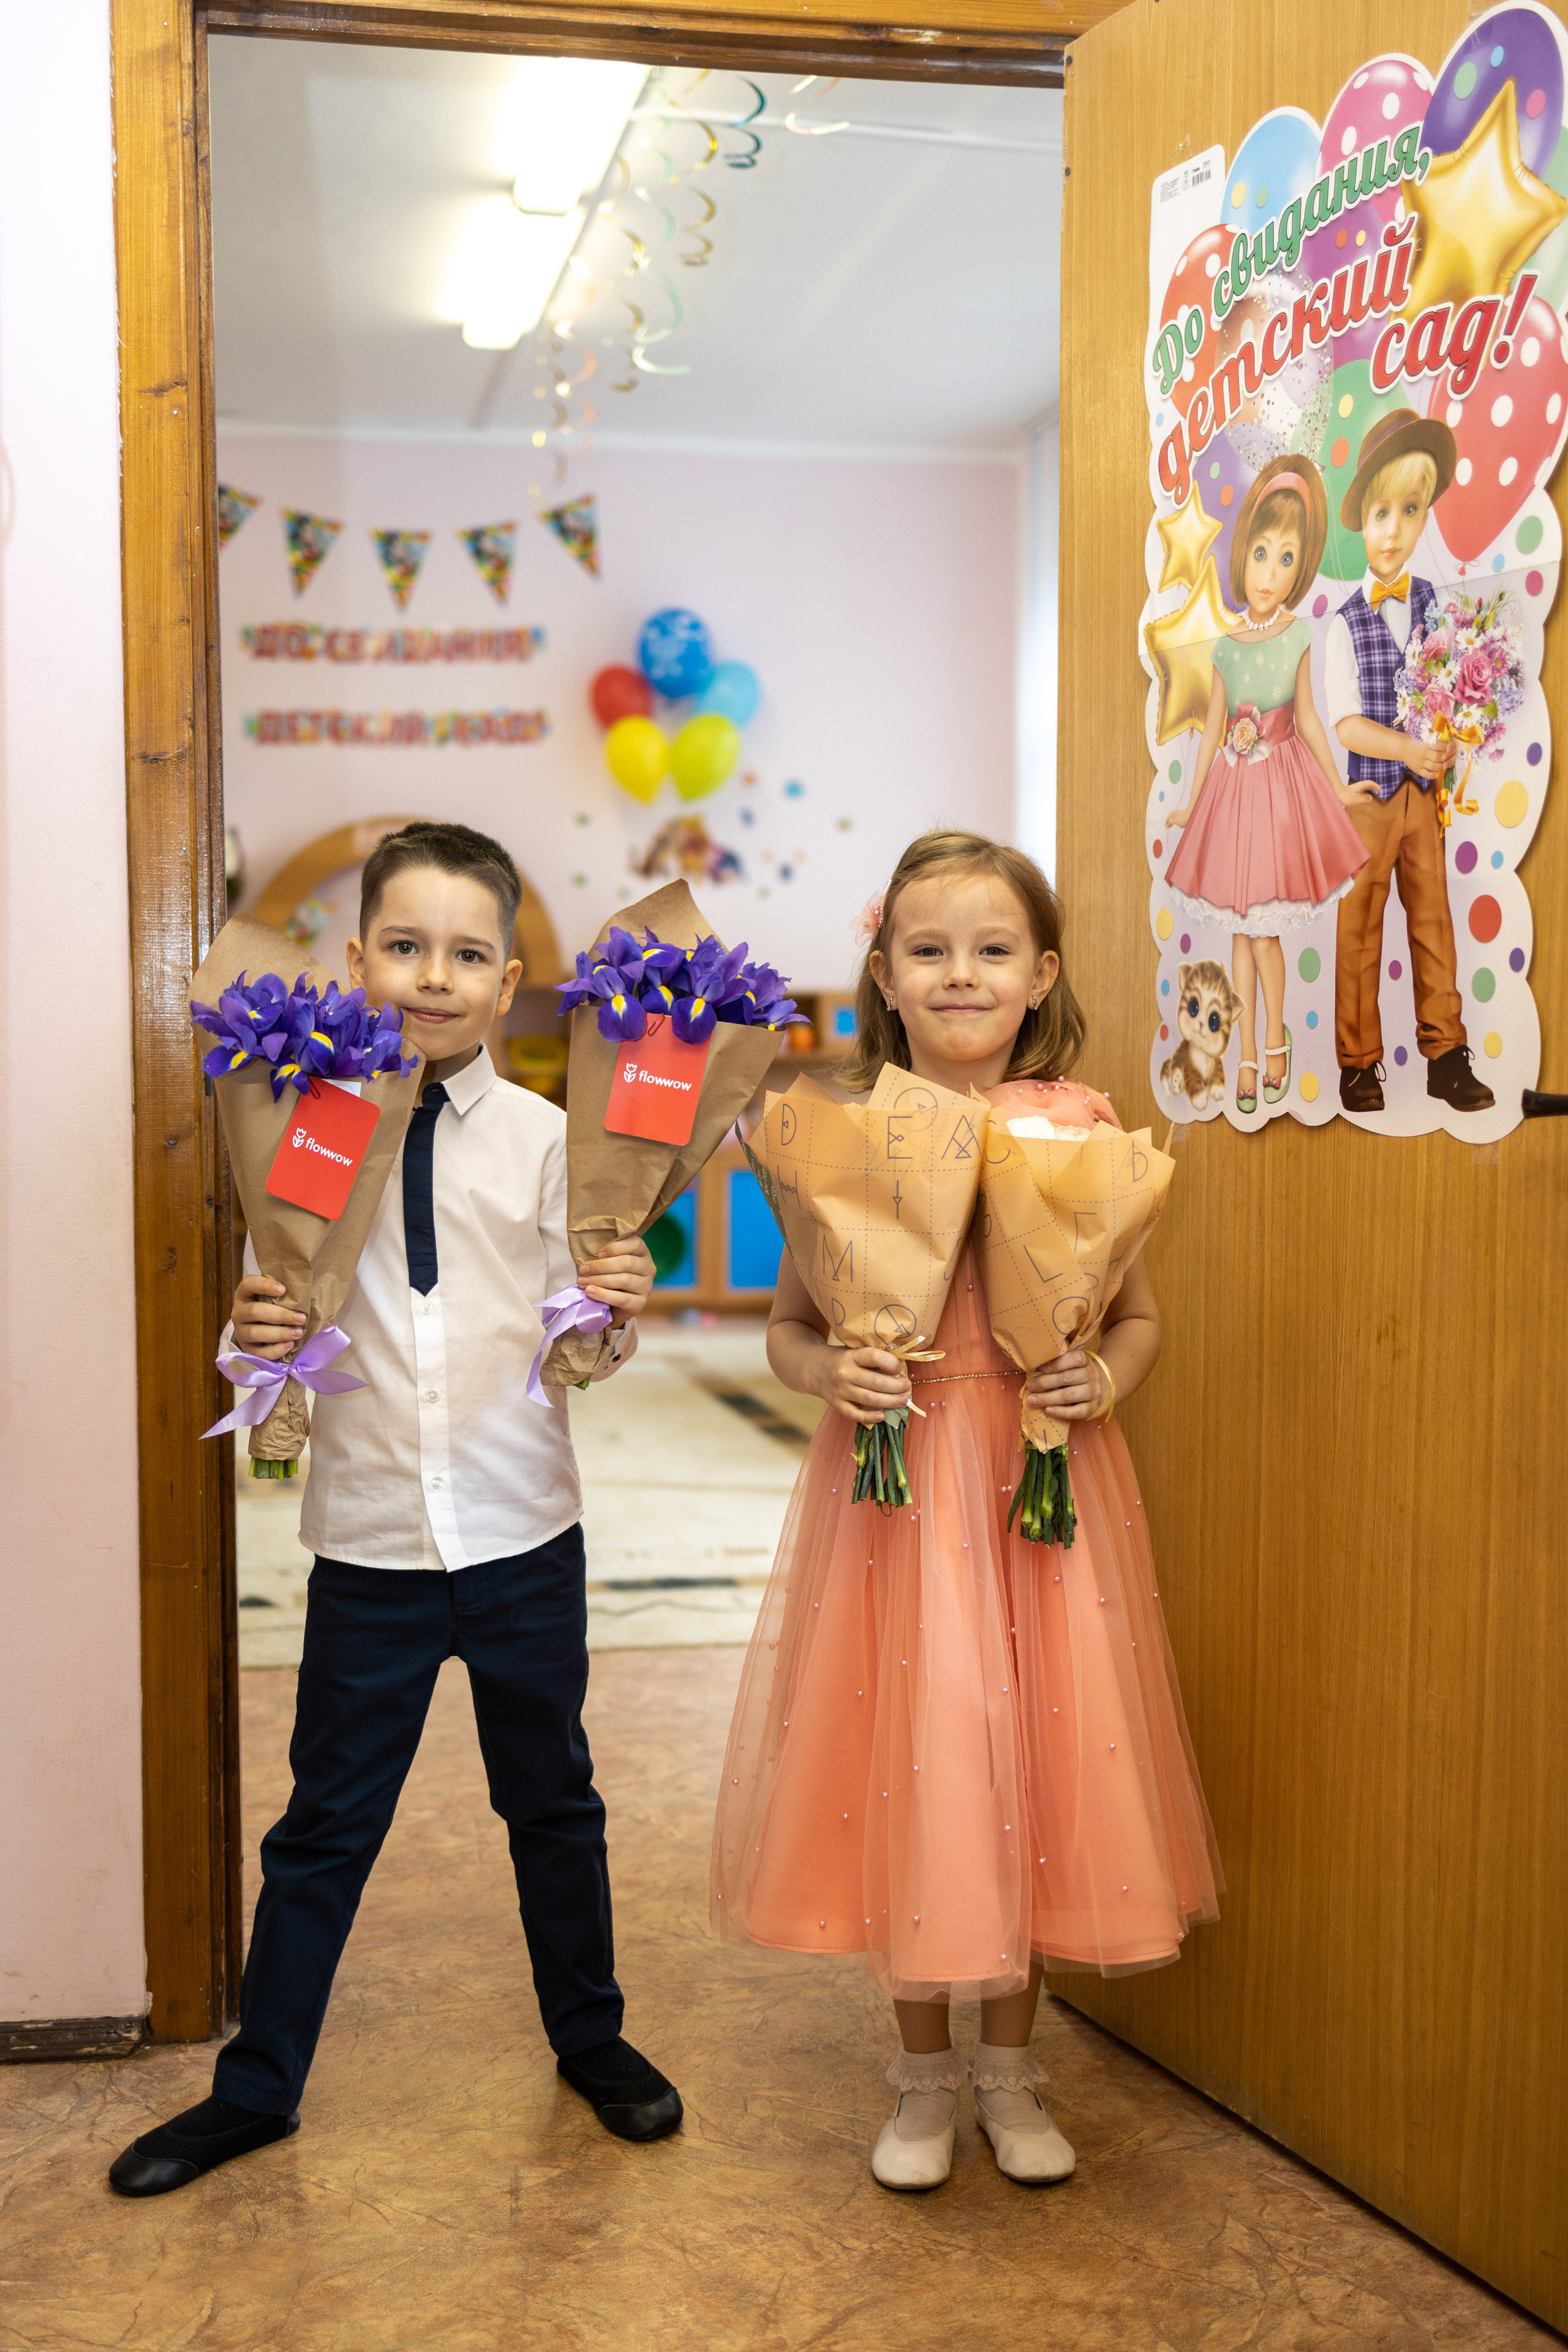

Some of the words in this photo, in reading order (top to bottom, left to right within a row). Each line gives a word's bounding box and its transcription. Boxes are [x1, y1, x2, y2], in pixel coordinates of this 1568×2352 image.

[1153, 308, 1202, 394] До
[1213, 126, 1430, 317] свидания,
[1158, 216, 1415, 505] детский
[1373, 274, 1537, 395] сад!
[638, 1070, 692, 1091] flowwow
[306, 1137, 353, 1167] flowwow
